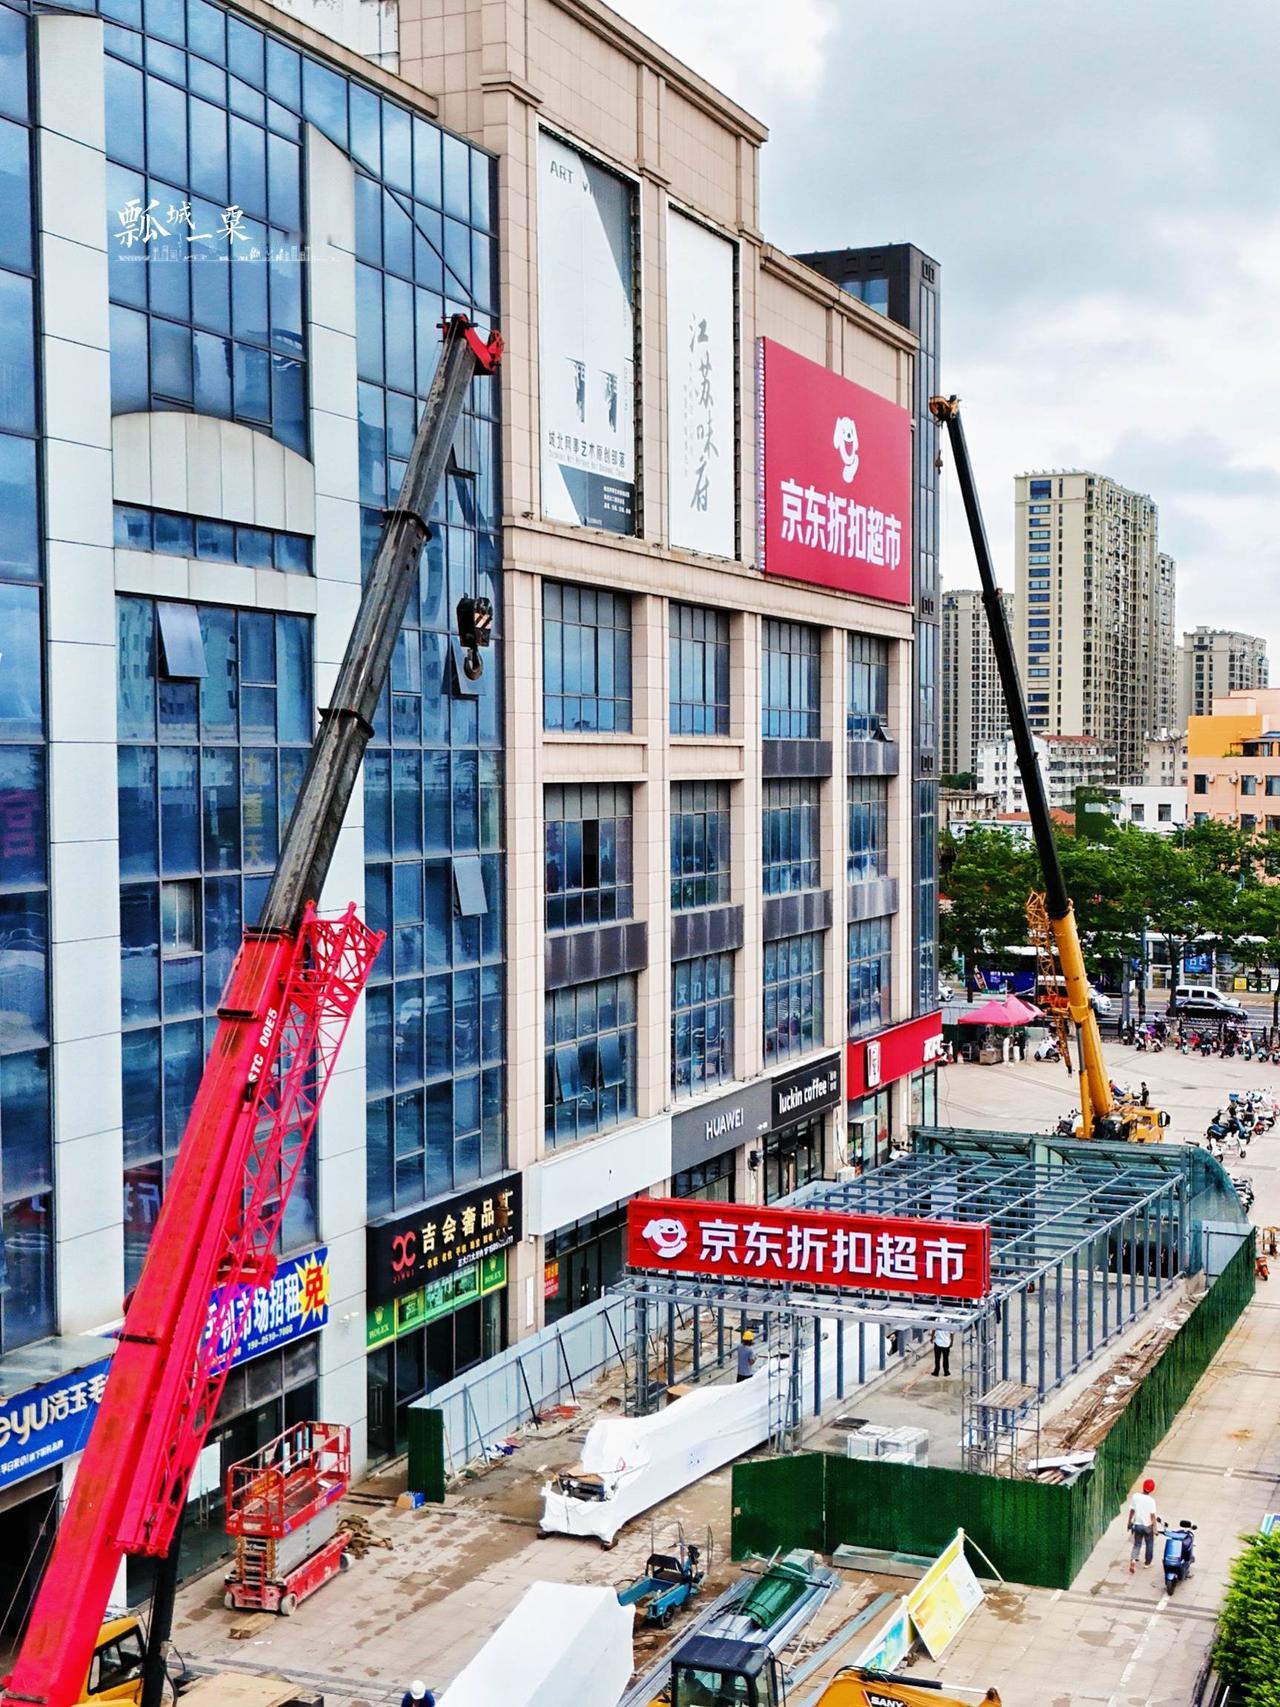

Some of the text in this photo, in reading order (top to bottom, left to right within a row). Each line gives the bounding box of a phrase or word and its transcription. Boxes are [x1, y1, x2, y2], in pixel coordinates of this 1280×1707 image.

[550, 160, 573, 184] ART
[780, 478, 902, 570] 京东折扣超市
[779, 1085, 803, 1114] luckin
[804, 1077, 827, 1103] coffee
[705, 1107, 744, 1140] HUAWEI
[698, 1218, 967, 1285] 京东折扣超市
[368, 1325, 390, 1339] ROLEX
